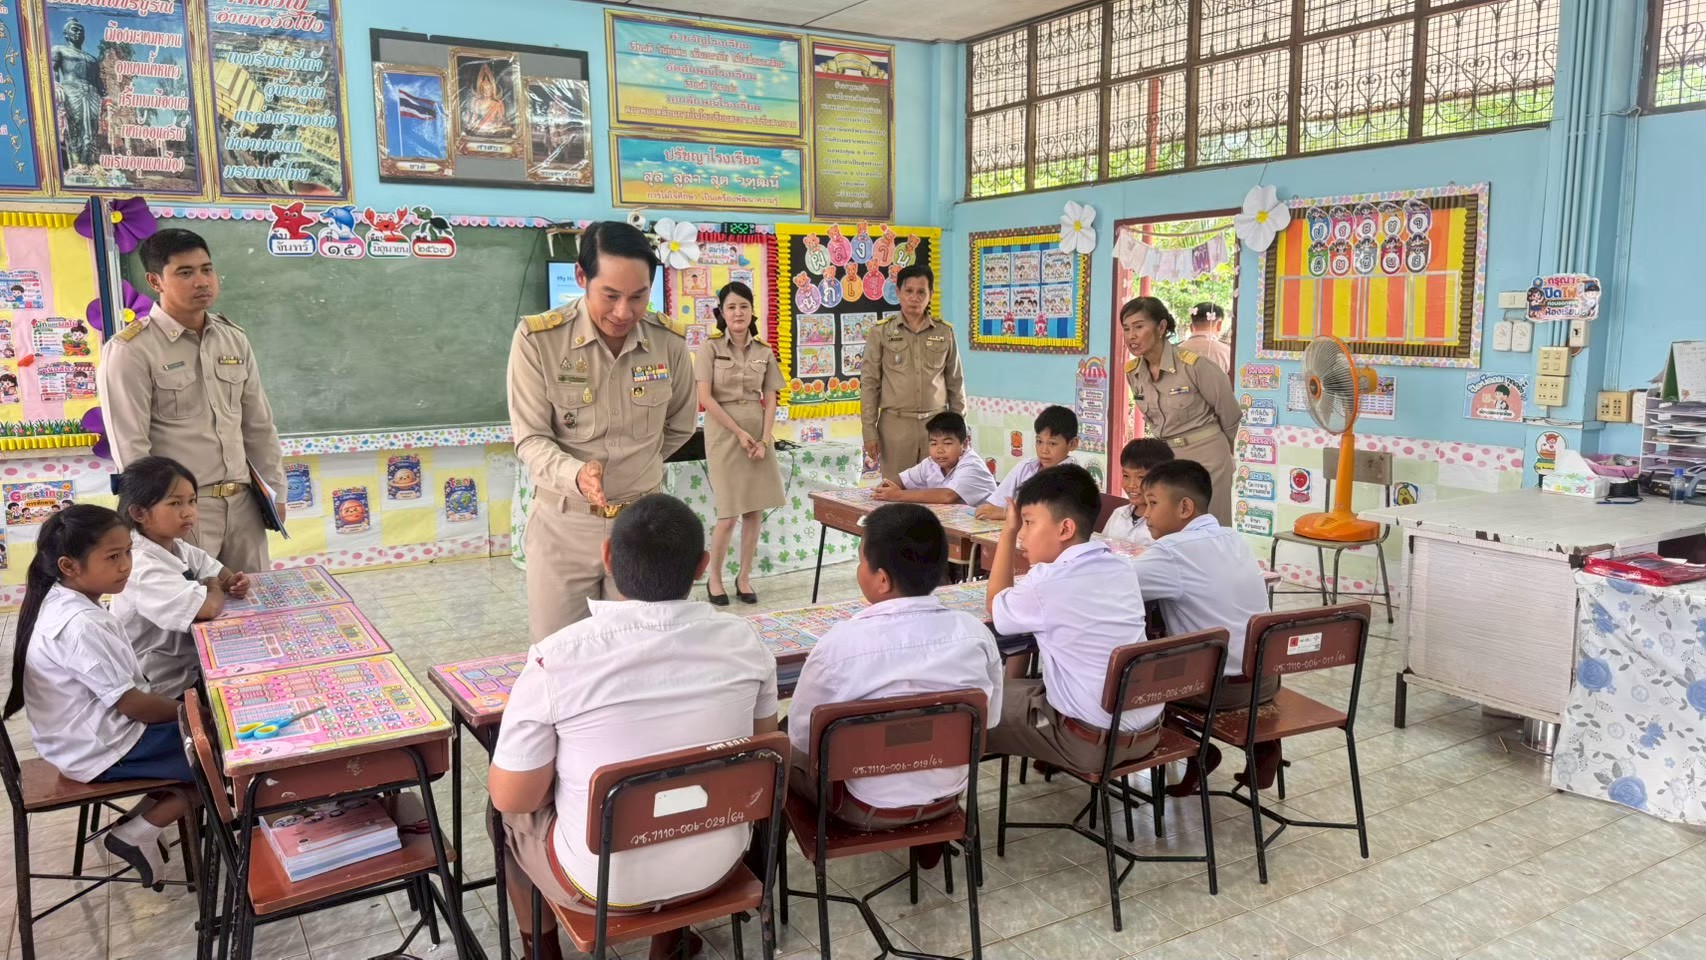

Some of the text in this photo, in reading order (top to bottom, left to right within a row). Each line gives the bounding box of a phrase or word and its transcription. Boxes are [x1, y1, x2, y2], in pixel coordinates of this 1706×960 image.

[104, 20, 183, 48] เมืองมะขามหวาน
[664, 146, 761, 167] ปรัชญาโรงเรียน
[223, 156, 311, 180] มรดกผ้าไทย
[277, 241, 308, 252] จันทร์
[328, 244, 356, 256] ๑๕
[373, 243, 409, 255] มิถุนายน
[1547, 276, 1575, 287] กรุณา
[1543, 286, 1577, 299] ปิดไฟ
[10, 489, 70, 502] Greetings
